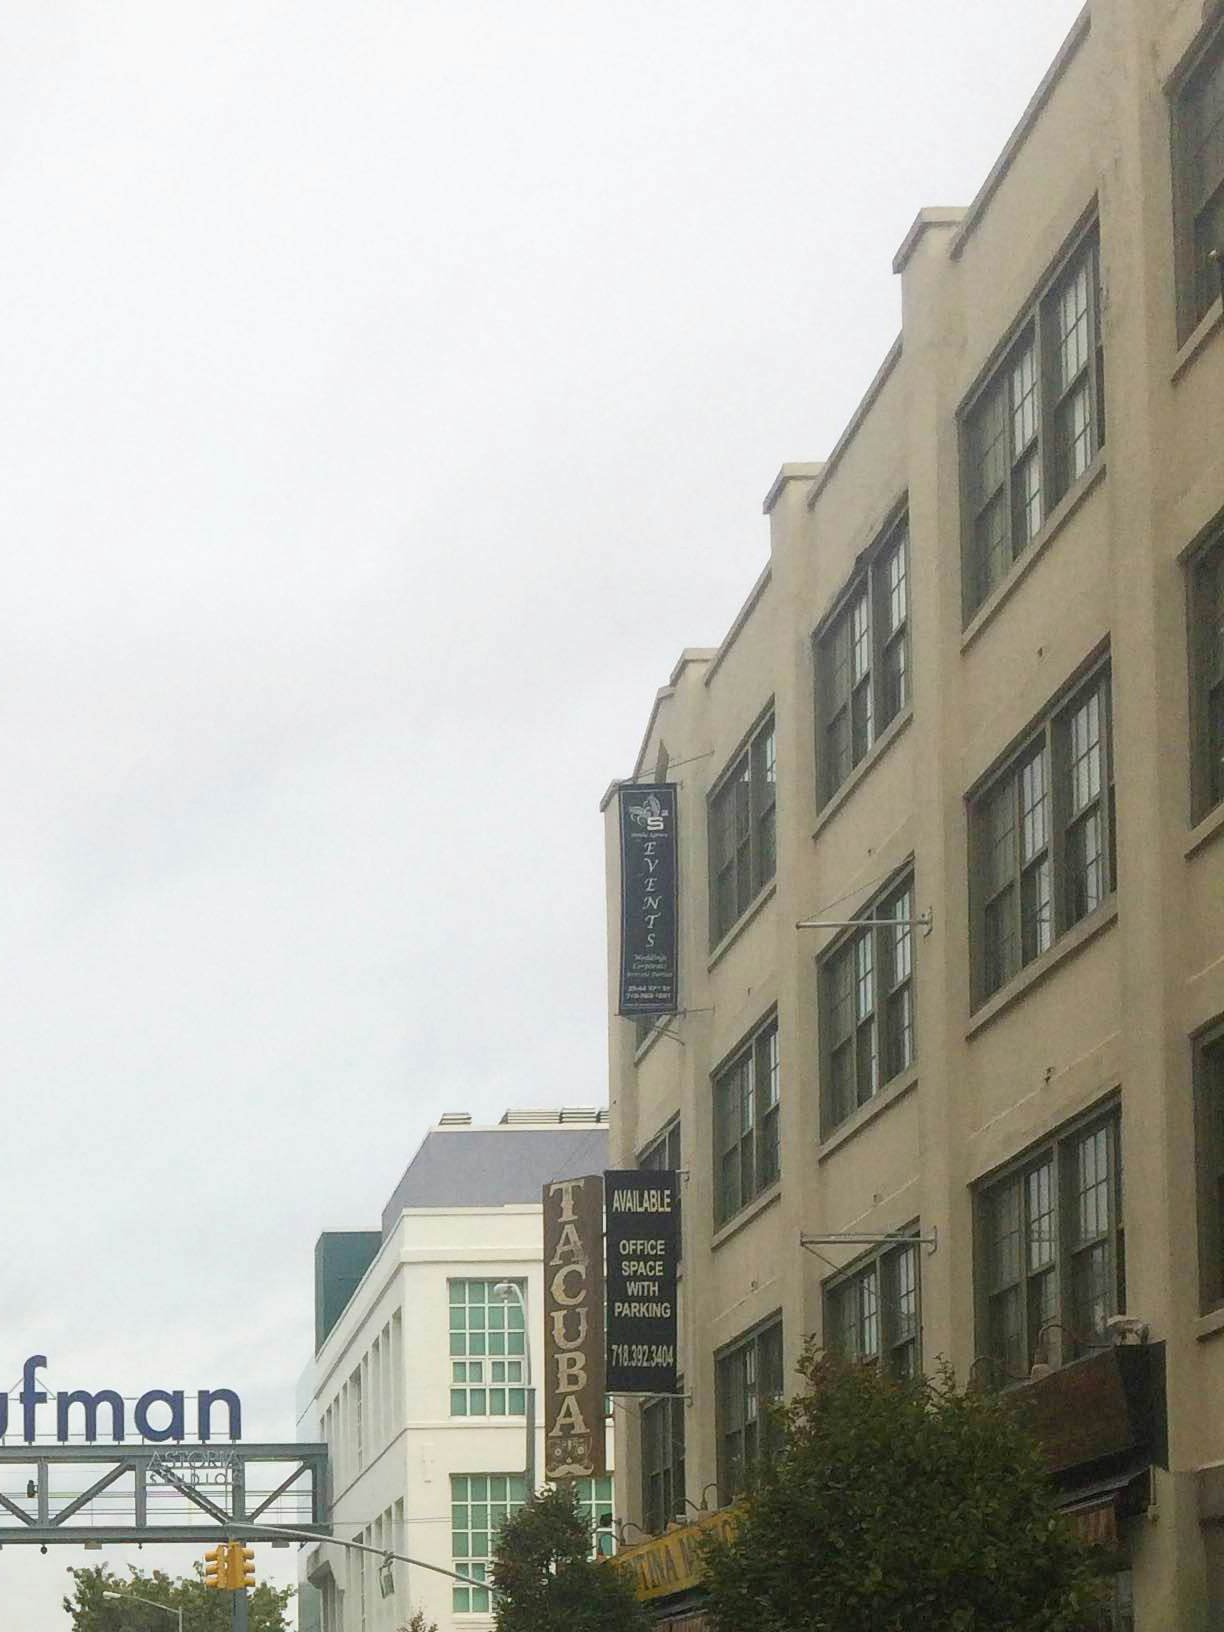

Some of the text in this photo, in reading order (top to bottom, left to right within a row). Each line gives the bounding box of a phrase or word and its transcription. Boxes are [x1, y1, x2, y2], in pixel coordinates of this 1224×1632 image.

[642, 841, 662, 948] EVENTS
[612, 1189, 672, 1213] AVAILABLE
[619, 1239, 665, 1256] OFFICE
[621, 1260, 664, 1276] SPACE
[626, 1281, 659, 1297] WITH
[548, 1178, 591, 1437] TACUBA
[614, 1302, 671, 1318] PARKING
[611, 1344, 674, 1369] 718.392.3404
